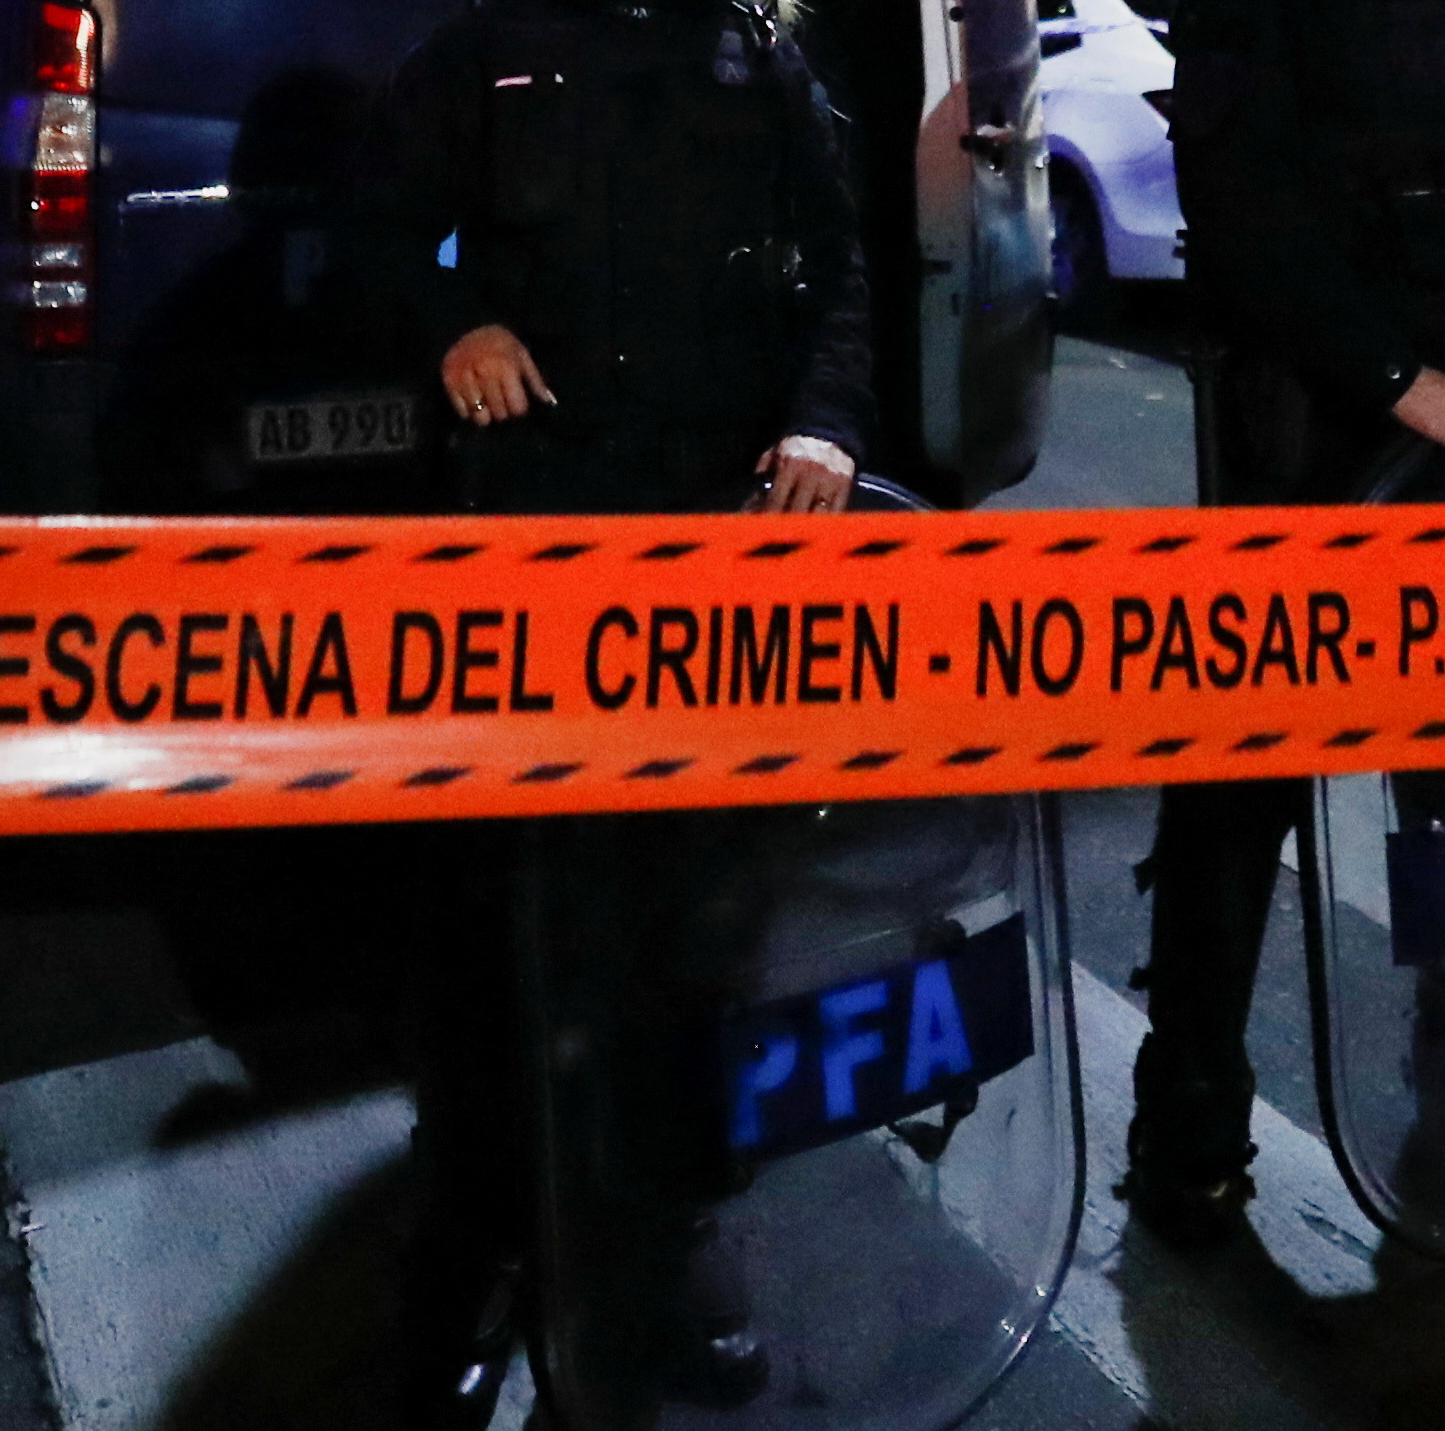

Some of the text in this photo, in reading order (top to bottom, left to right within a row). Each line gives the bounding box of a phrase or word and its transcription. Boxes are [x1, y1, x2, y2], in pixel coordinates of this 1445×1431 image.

[259, 408, 309, 453] AB
[387, 610, 554, 715] DEL
[586, 604, 899, 711] CRIMEN
[976, 598, 1084, 697] NO
[728, 959, 974, 1150] PFA
